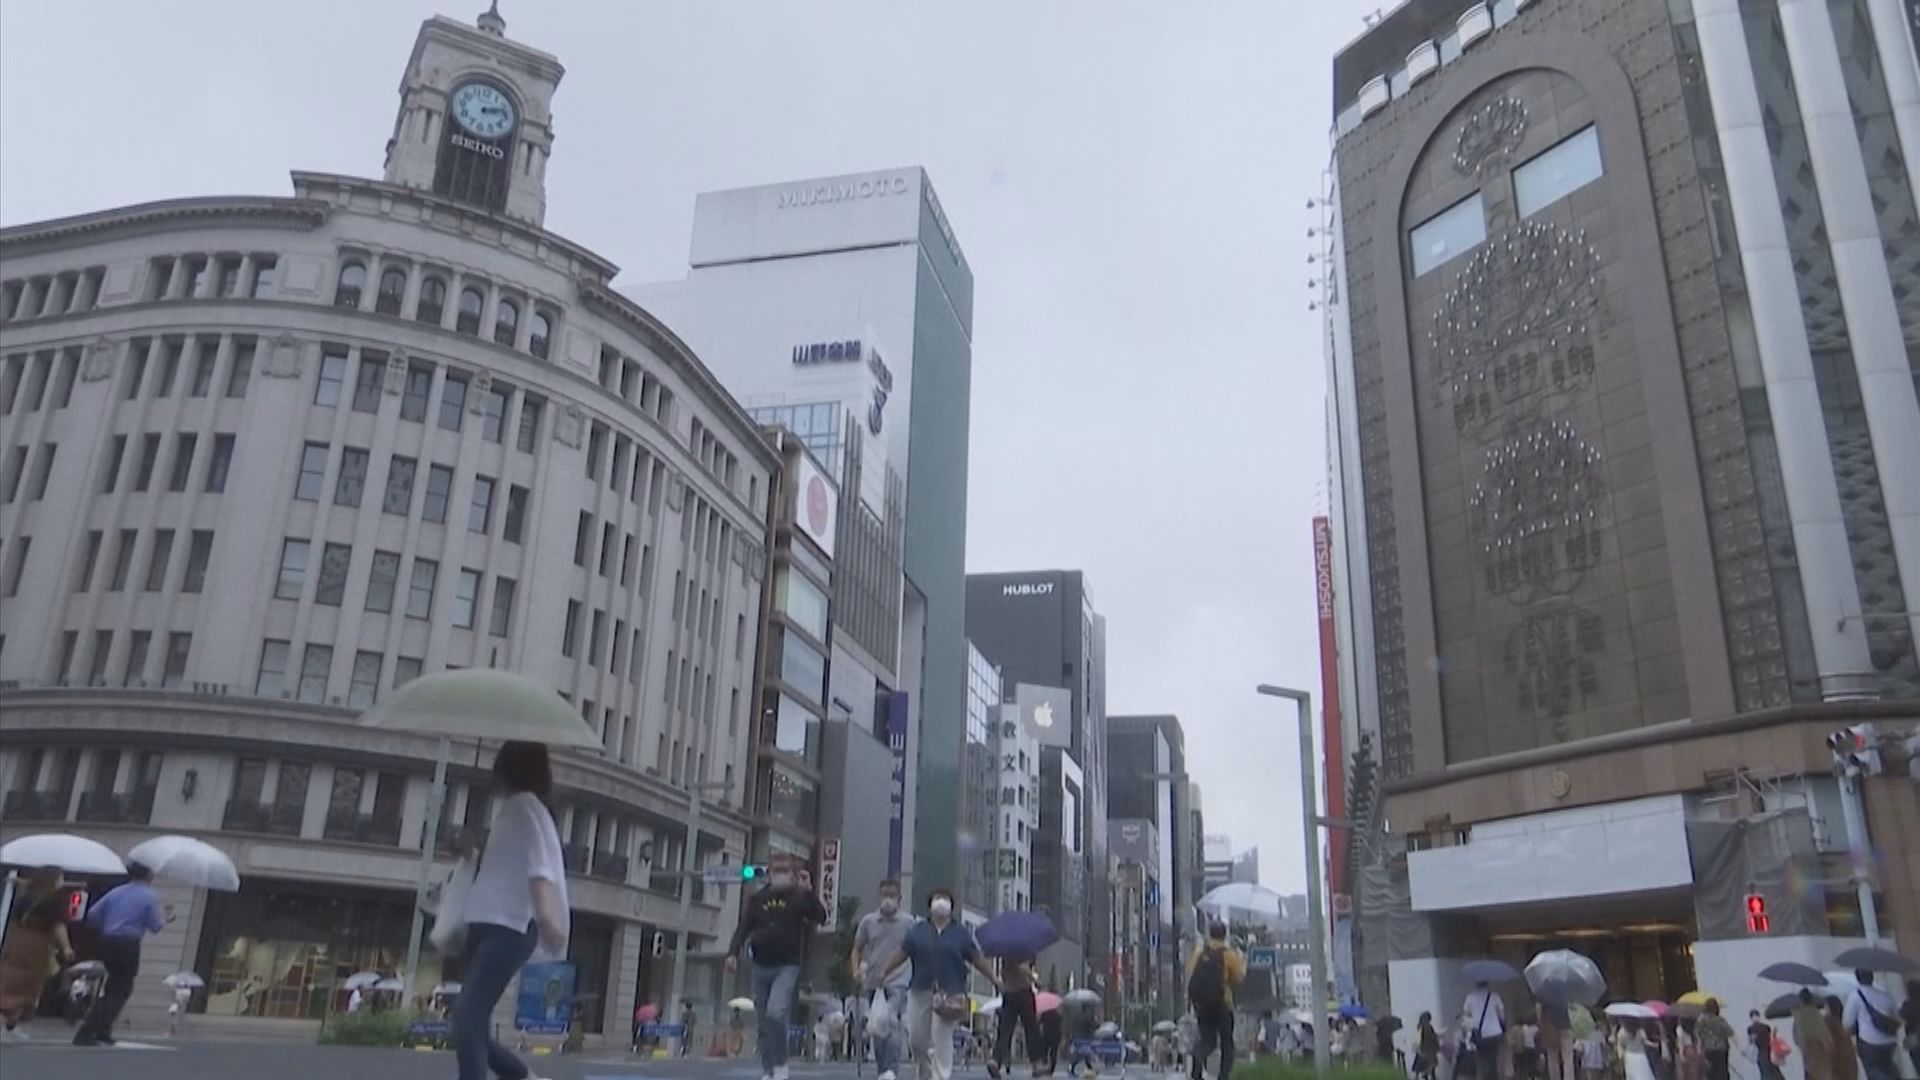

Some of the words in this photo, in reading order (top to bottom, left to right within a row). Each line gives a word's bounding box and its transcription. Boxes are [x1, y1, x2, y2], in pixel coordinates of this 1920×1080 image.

[451, 134, 504, 160] SEIKO
[778, 177, 908, 210] MIKIMOTO
[1315, 519, 1332, 619] MITSUKOSHI
[1003, 582, 1054, 596] HUBLOT
